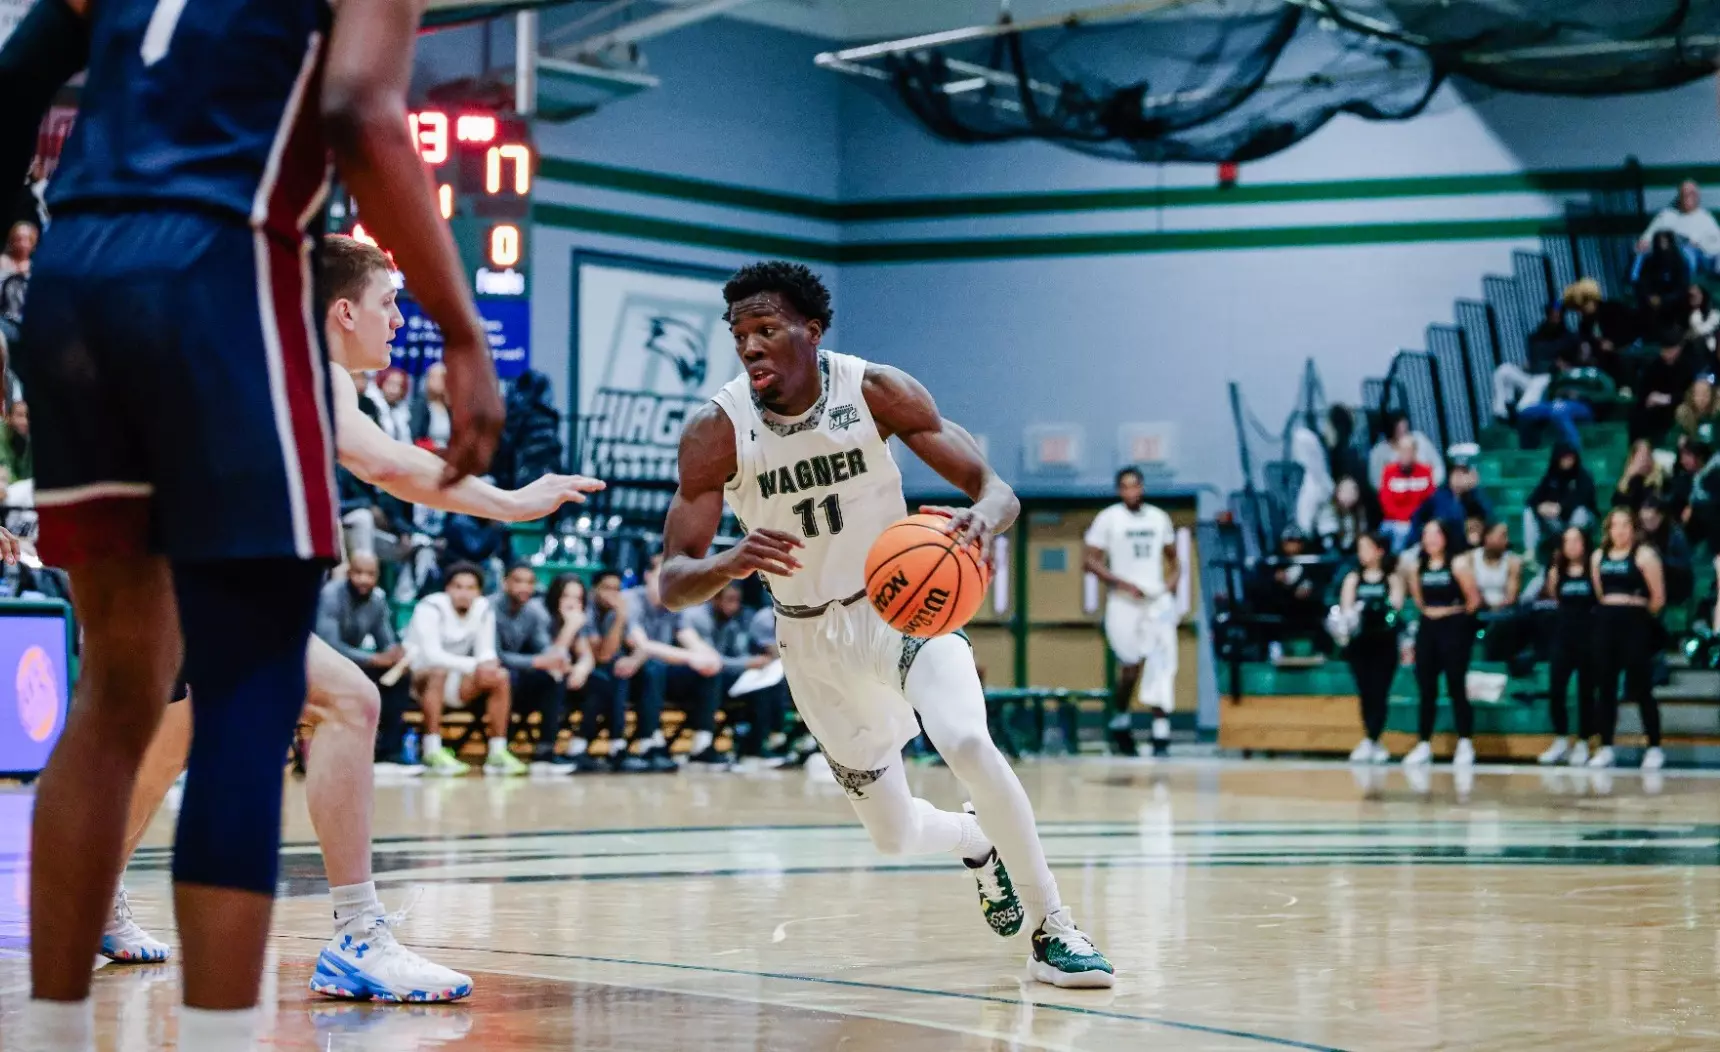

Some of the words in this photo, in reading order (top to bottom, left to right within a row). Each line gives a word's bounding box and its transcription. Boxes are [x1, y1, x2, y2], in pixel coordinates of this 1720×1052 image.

[486, 144, 530, 195] 17
[491, 225, 519, 266] 0
[757, 448, 868, 499] WAGNER
[791, 493, 844, 538] 11
[902, 586, 951, 634] Wilso
